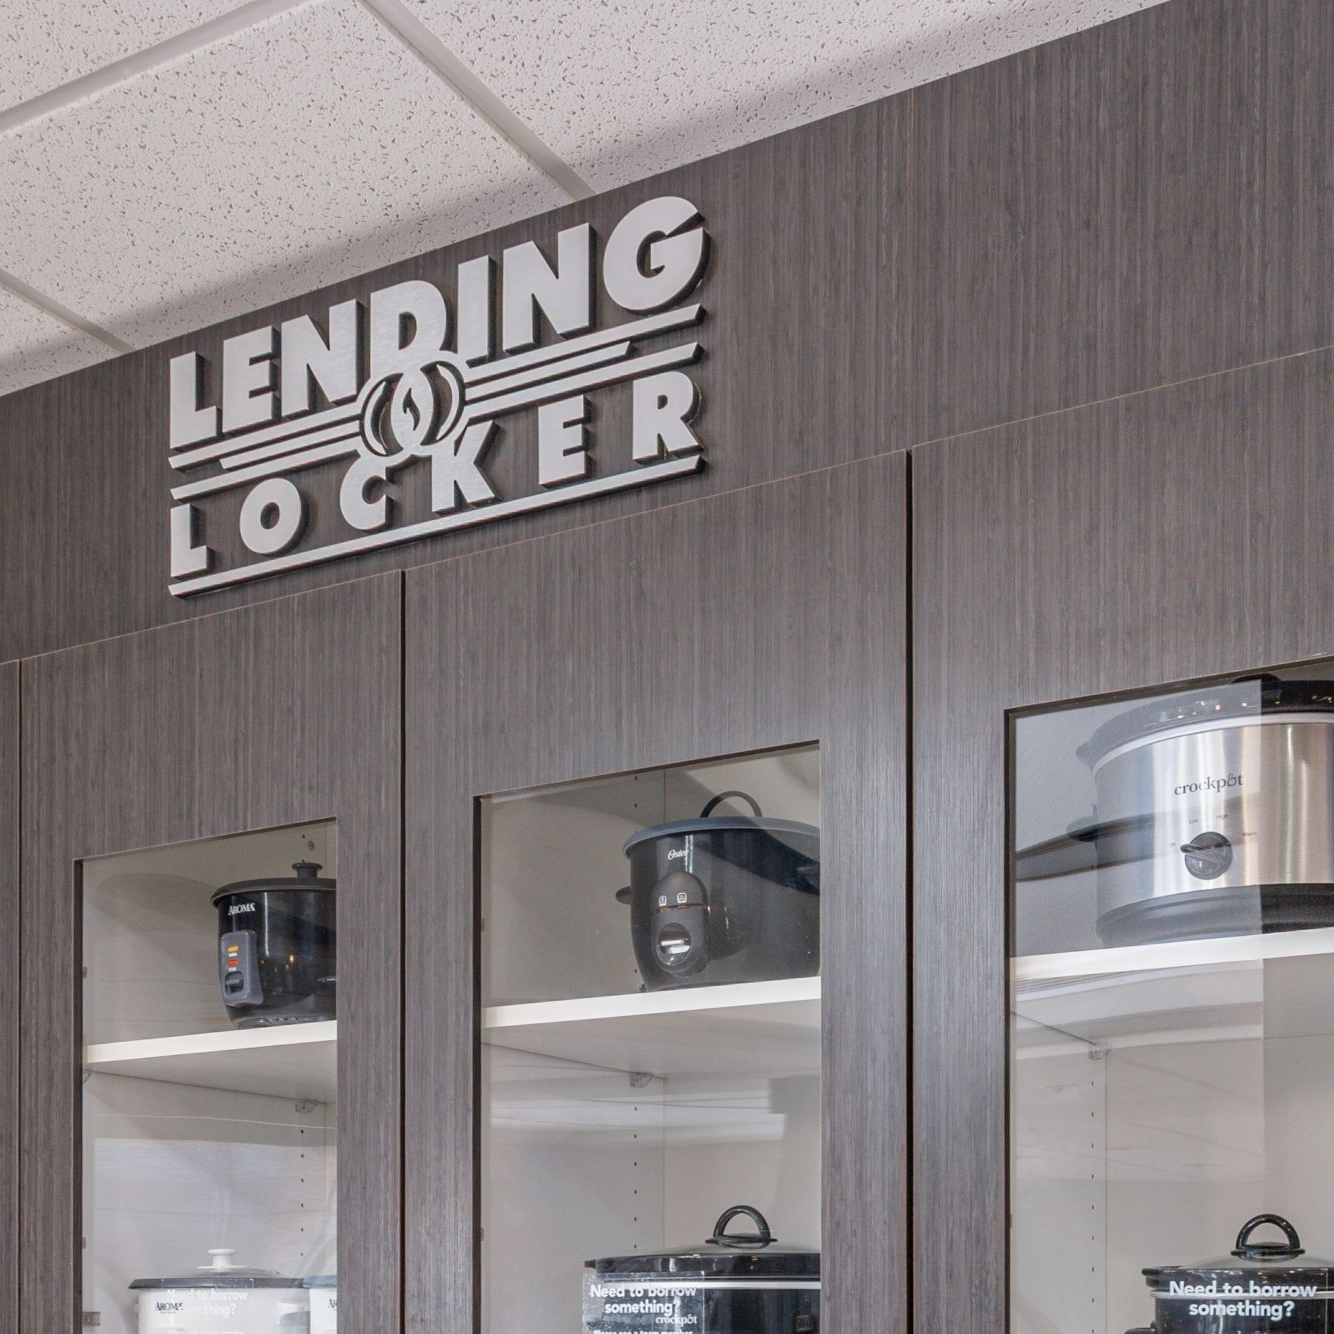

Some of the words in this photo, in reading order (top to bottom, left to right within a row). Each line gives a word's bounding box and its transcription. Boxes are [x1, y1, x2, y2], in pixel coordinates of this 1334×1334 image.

[170, 196, 706, 450] LENDING
[170, 371, 703, 577] LOCKER
[667, 848, 689, 860] Oster
[228, 902, 256, 916] AROMA
[590, 1284, 625, 1297] Need
[629, 1286, 644, 1297] to
[648, 1285, 696, 1297] borrow
[1169, 1280, 1217, 1296] Need
[1223, 1282, 1243, 1296] to
[1249, 1280, 1317, 1297] borrow
[605, 1299, 681, 1316] something?
[1189, 1300, 1295, 1321] something?
